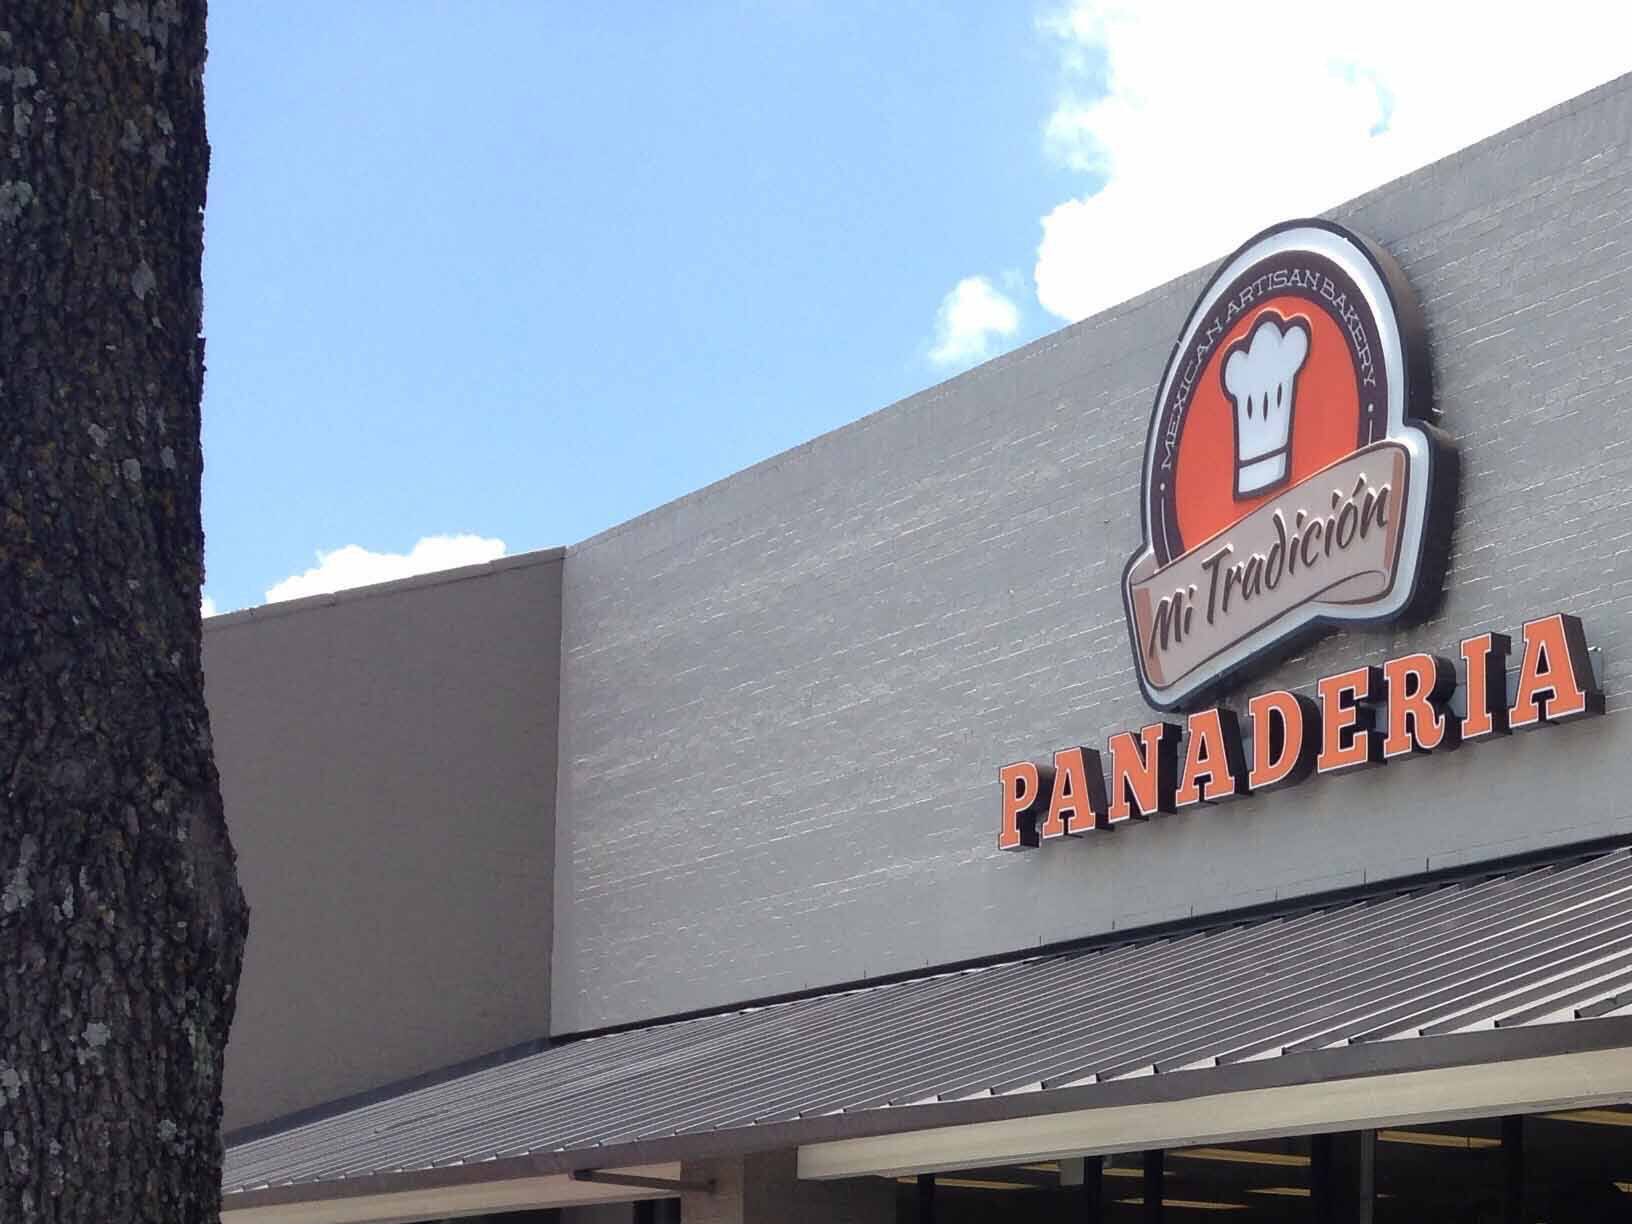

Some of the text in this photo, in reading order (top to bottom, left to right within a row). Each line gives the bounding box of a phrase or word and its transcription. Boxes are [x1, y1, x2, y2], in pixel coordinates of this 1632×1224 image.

[1160, 269, 1377, 471] MEXICAN ARTISAN BAKERY
[1149, 472, 1392, 658] Mi Tradición
[998, 612, 1588, 850] PANADERIA
